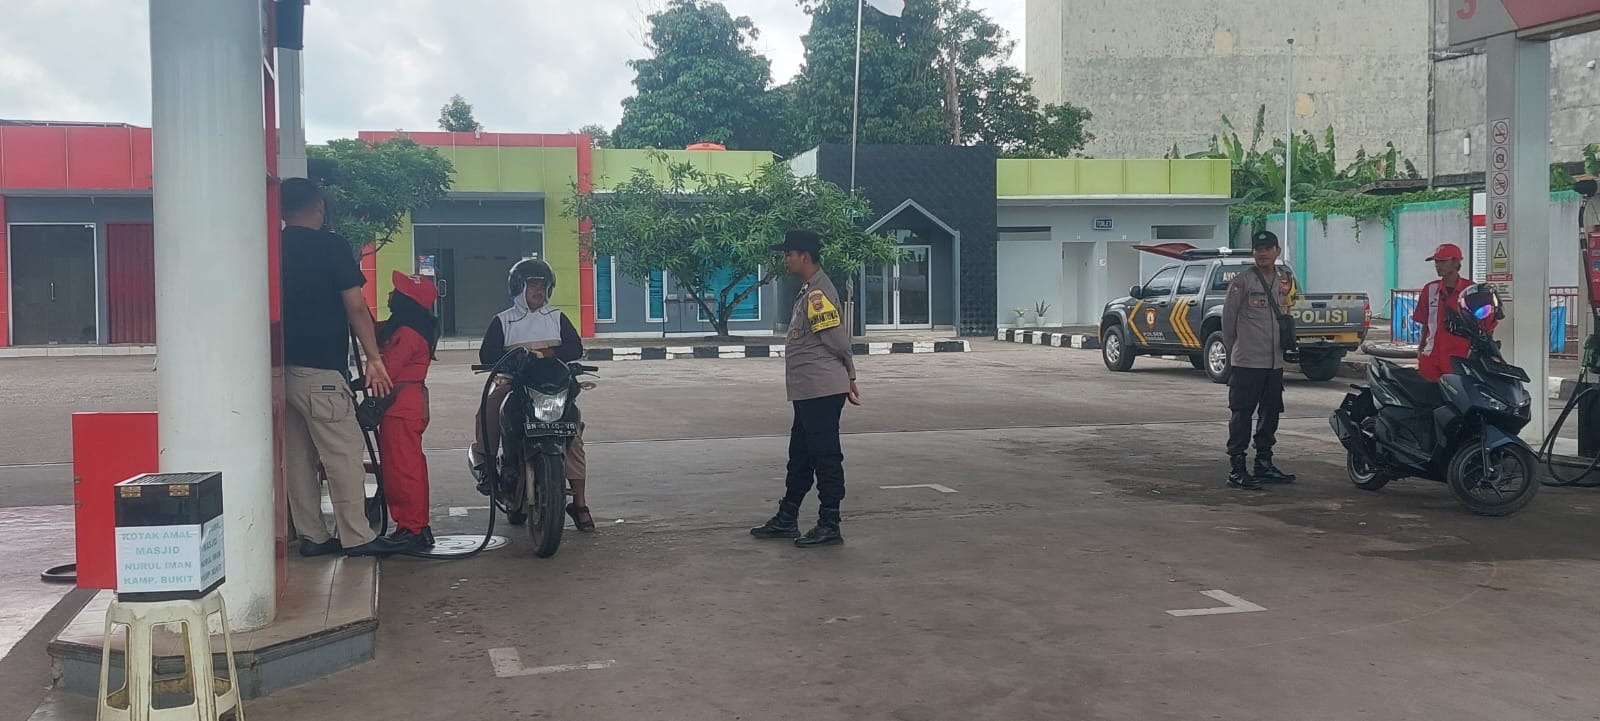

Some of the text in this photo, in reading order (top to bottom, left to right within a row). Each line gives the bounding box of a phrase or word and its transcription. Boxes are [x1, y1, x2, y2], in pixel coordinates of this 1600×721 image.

[1290, 309, 1348, 323] POLISI
[122, 531, 193, 541] KOTAK AMAL
[135, 546, 180, 555] MASJID
[124, 561, 192, 570] NURUL IMAN
[124, 577, 158, 585] KAMP.
[161, 576, 193, 584] BUKIT
